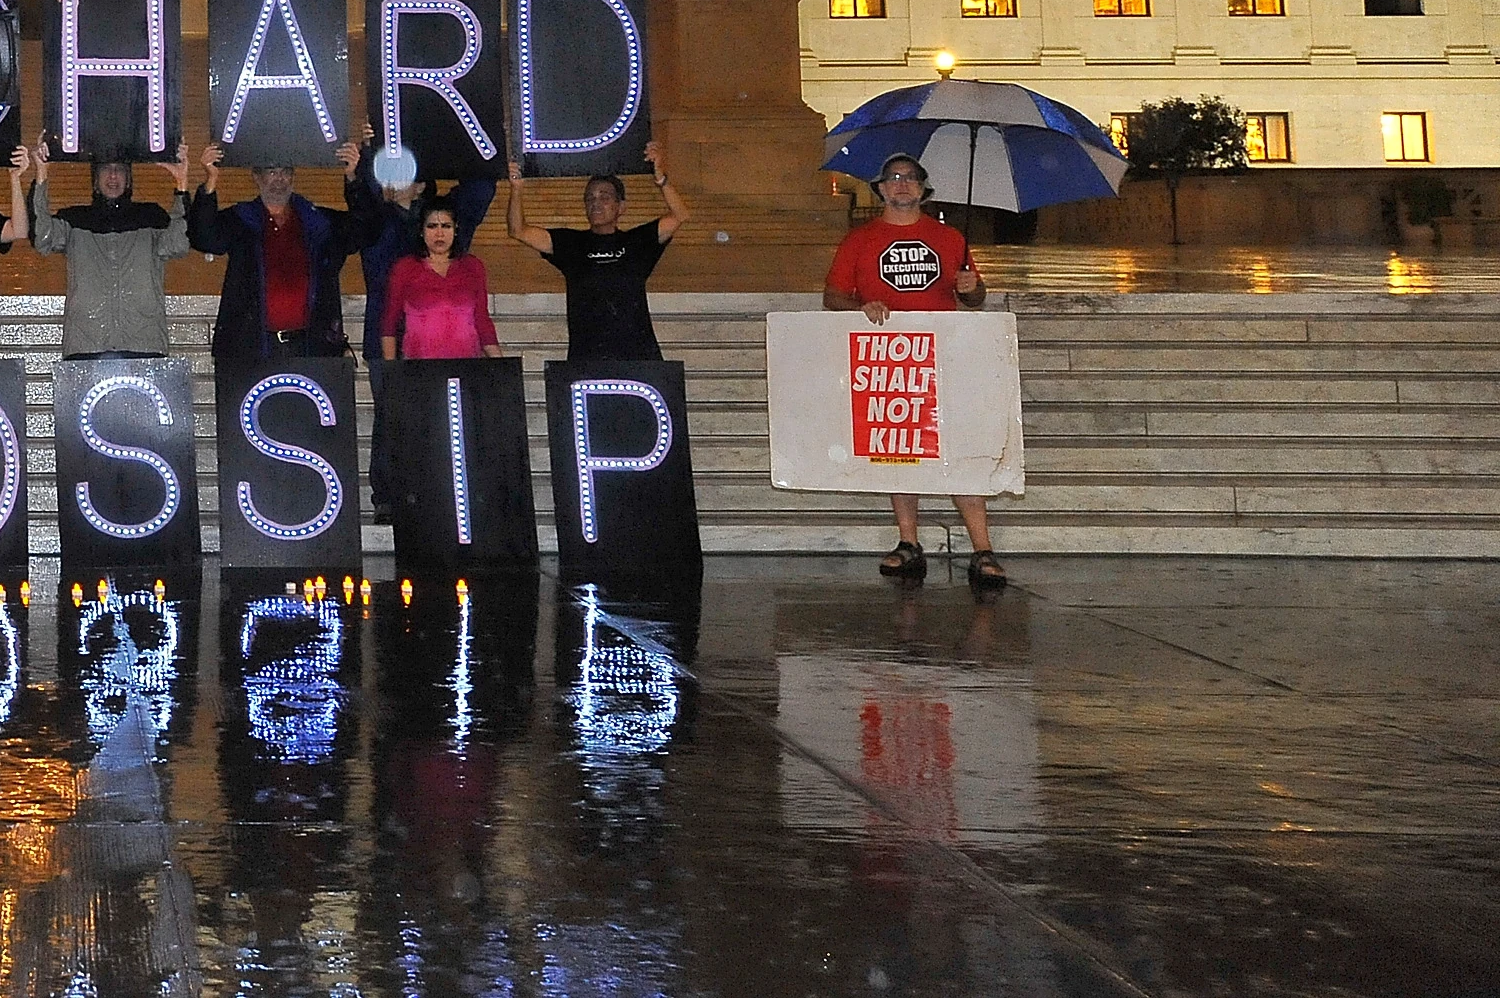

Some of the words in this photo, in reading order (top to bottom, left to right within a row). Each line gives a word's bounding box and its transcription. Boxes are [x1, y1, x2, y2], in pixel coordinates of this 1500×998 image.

[883, 262, 937, 273] EXECUTIONS
[889, 247, 929, 263] STOP
[894, 273, 927, 286] NOW!
[857, 335, 931, 362] THOU
[852, 365, 935, 393] SHALT
[867, 396, 925, 424] NOT
[868, 427, 925, 455] KILL
